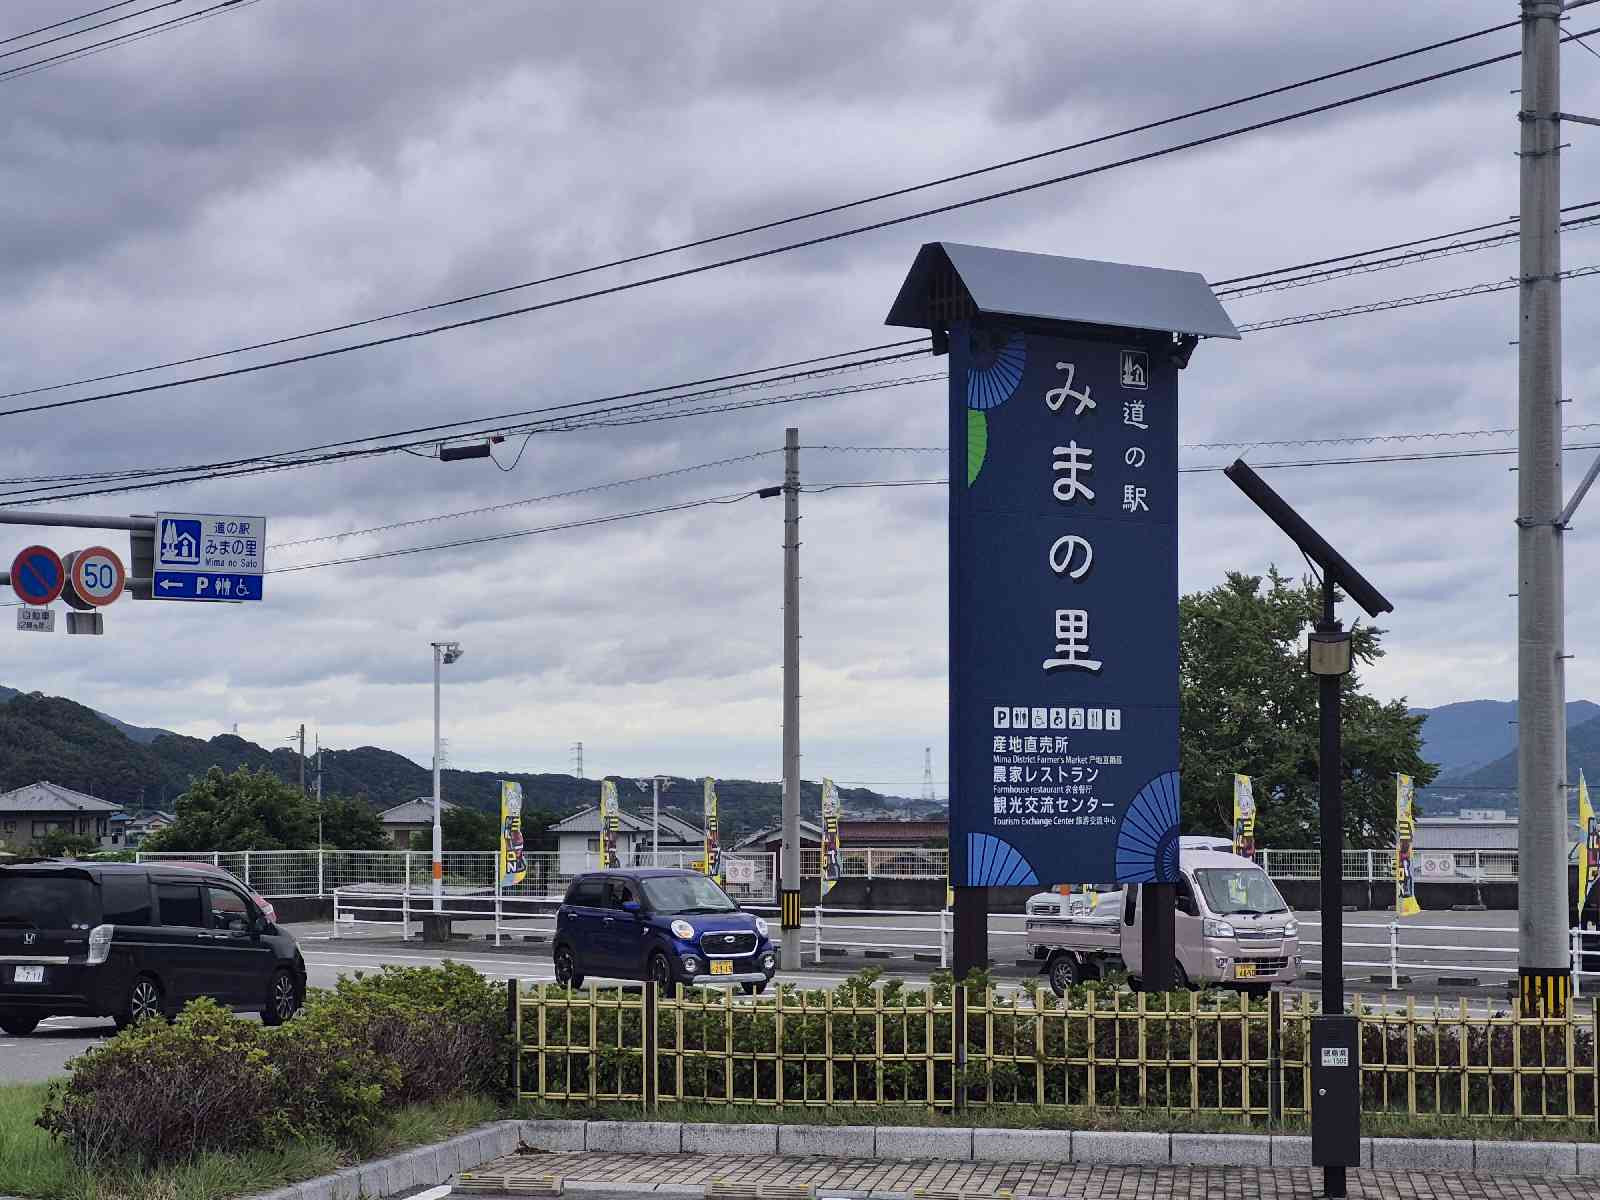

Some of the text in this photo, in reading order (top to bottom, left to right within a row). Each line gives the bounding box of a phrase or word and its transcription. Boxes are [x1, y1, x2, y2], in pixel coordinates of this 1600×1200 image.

[1122, 399, 1149, 513] 道の駅
[1043, 361, 1103, 671] みまの里
[215, 521, 250, 535] 道の駅
[205, 539, 257, 557] みまの里
[84, 563, 113, 589] 50
[197, 576, 209, 595] P
[997, 710, 1007, 725] P
[993, 736, 1069, 753] 産地直売所
[993, 755, 1012, 764] Mima
[1013, 755, 1036, 764] District
[1066, 755, 1088, 764] Market
[993, 766, 1099, 783] 農家レストラン
[993, 784, 1030, 794] Farmhouse
[1031, 786, 1064, 794] restaurant
[993, 796, 1115, 814] 観光交流センター
[993, 816, 1020, 825] Tourism
[1021, 816, 1053, 828] Exchange
[1053, 816, 1074, 825] Center
